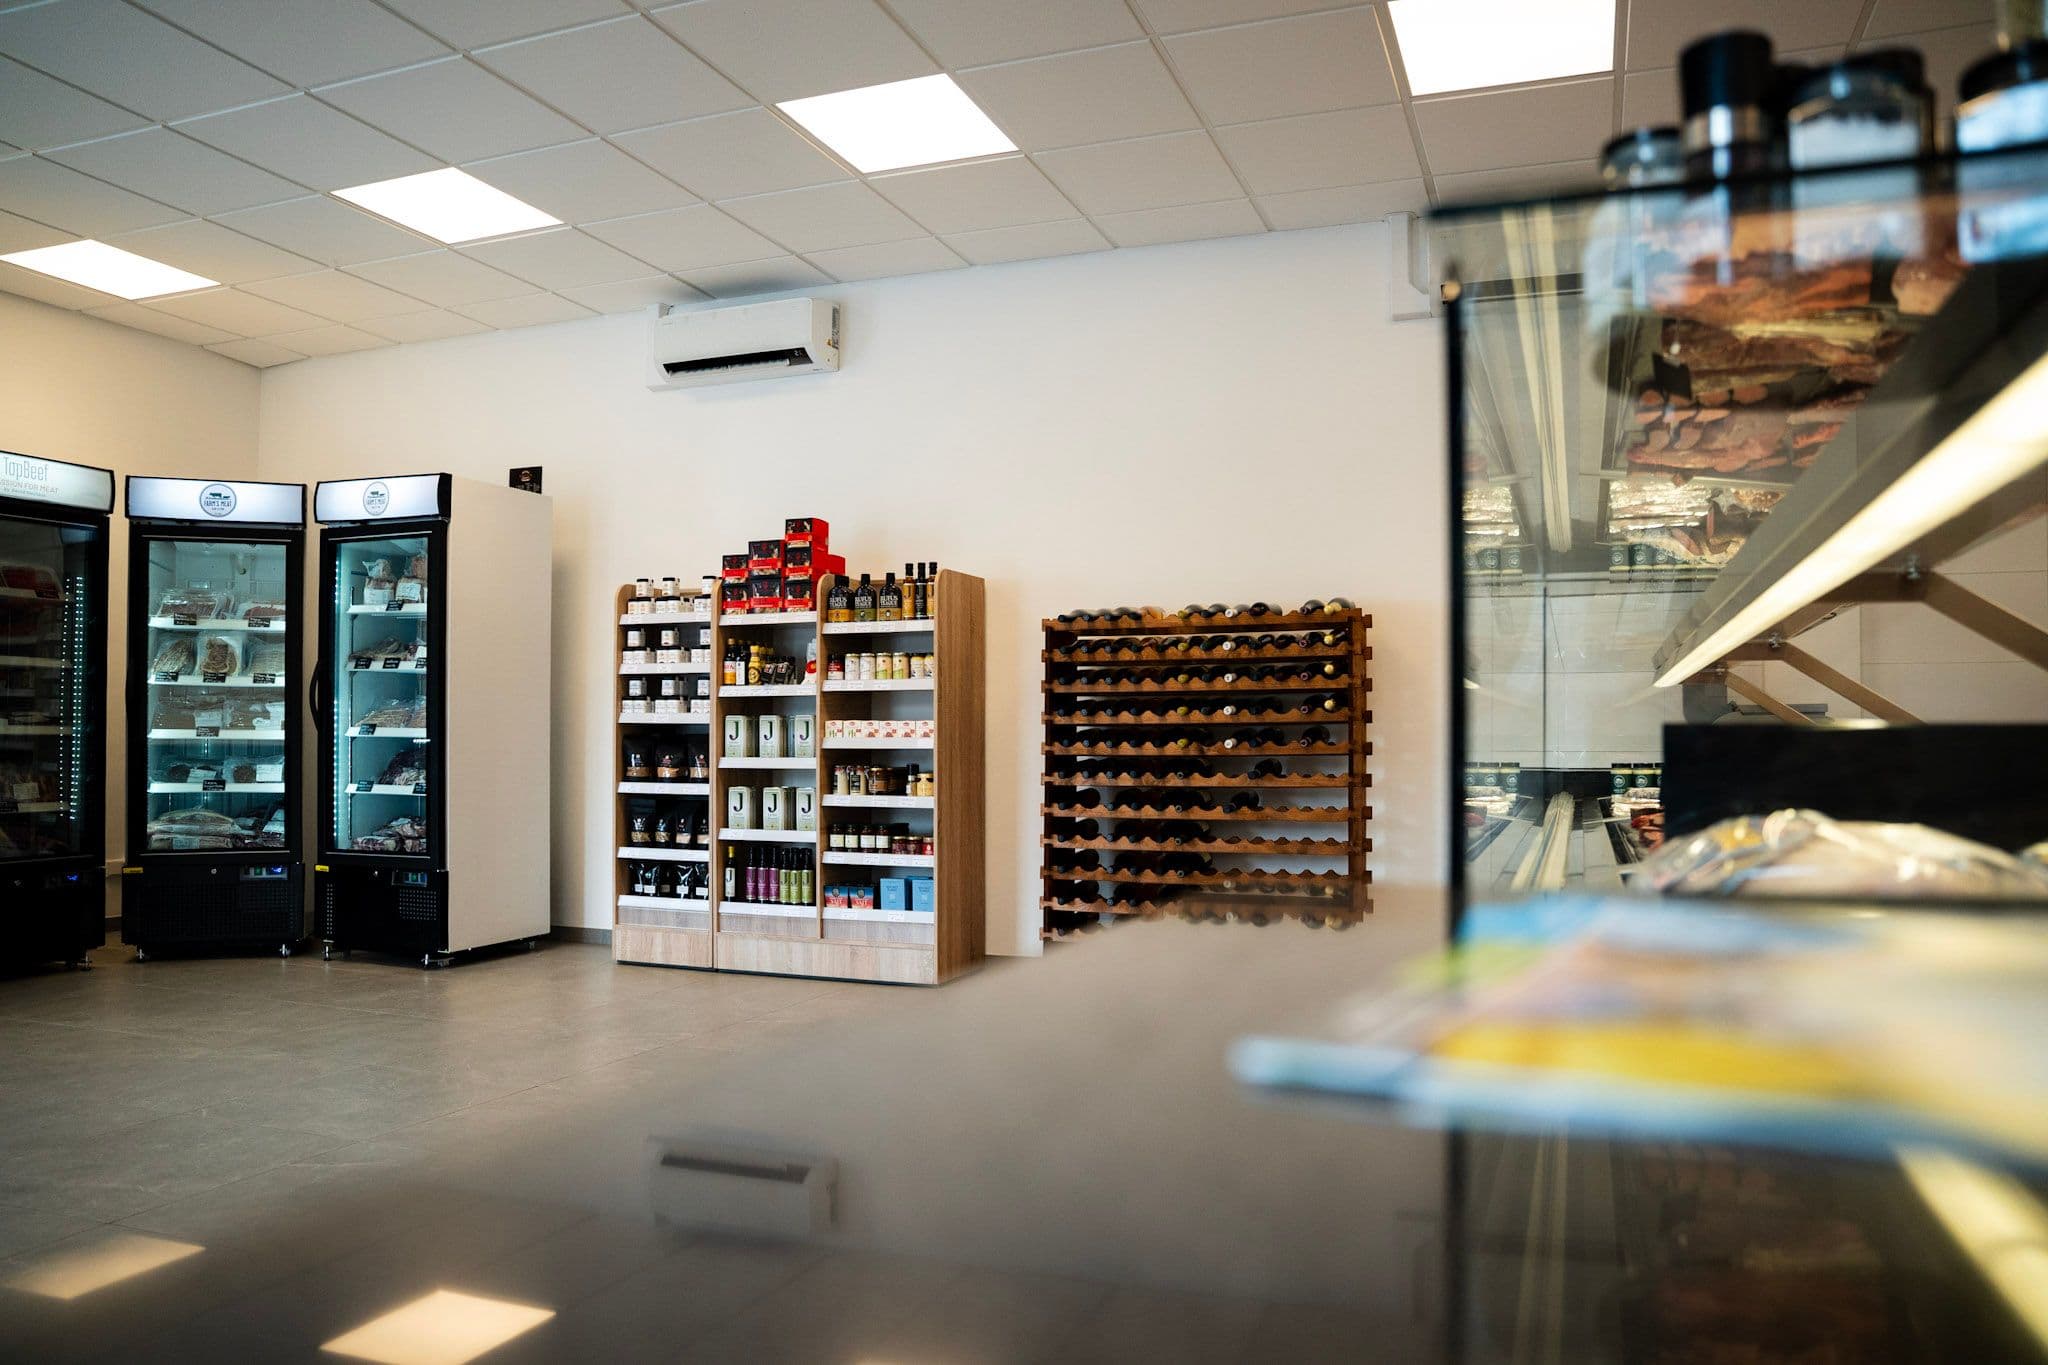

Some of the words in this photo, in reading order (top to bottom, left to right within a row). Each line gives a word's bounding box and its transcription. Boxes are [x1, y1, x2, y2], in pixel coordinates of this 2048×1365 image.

[3, 457, 48, 481] TopBeef
[729, 720, 739, 741] J
[764, 720, 773, 741] J
[799, 720, 810, 741] J
[733, 792, 743, 812] J
[767, 793, 777, 813] J
[801, 793, 811, 814] J
